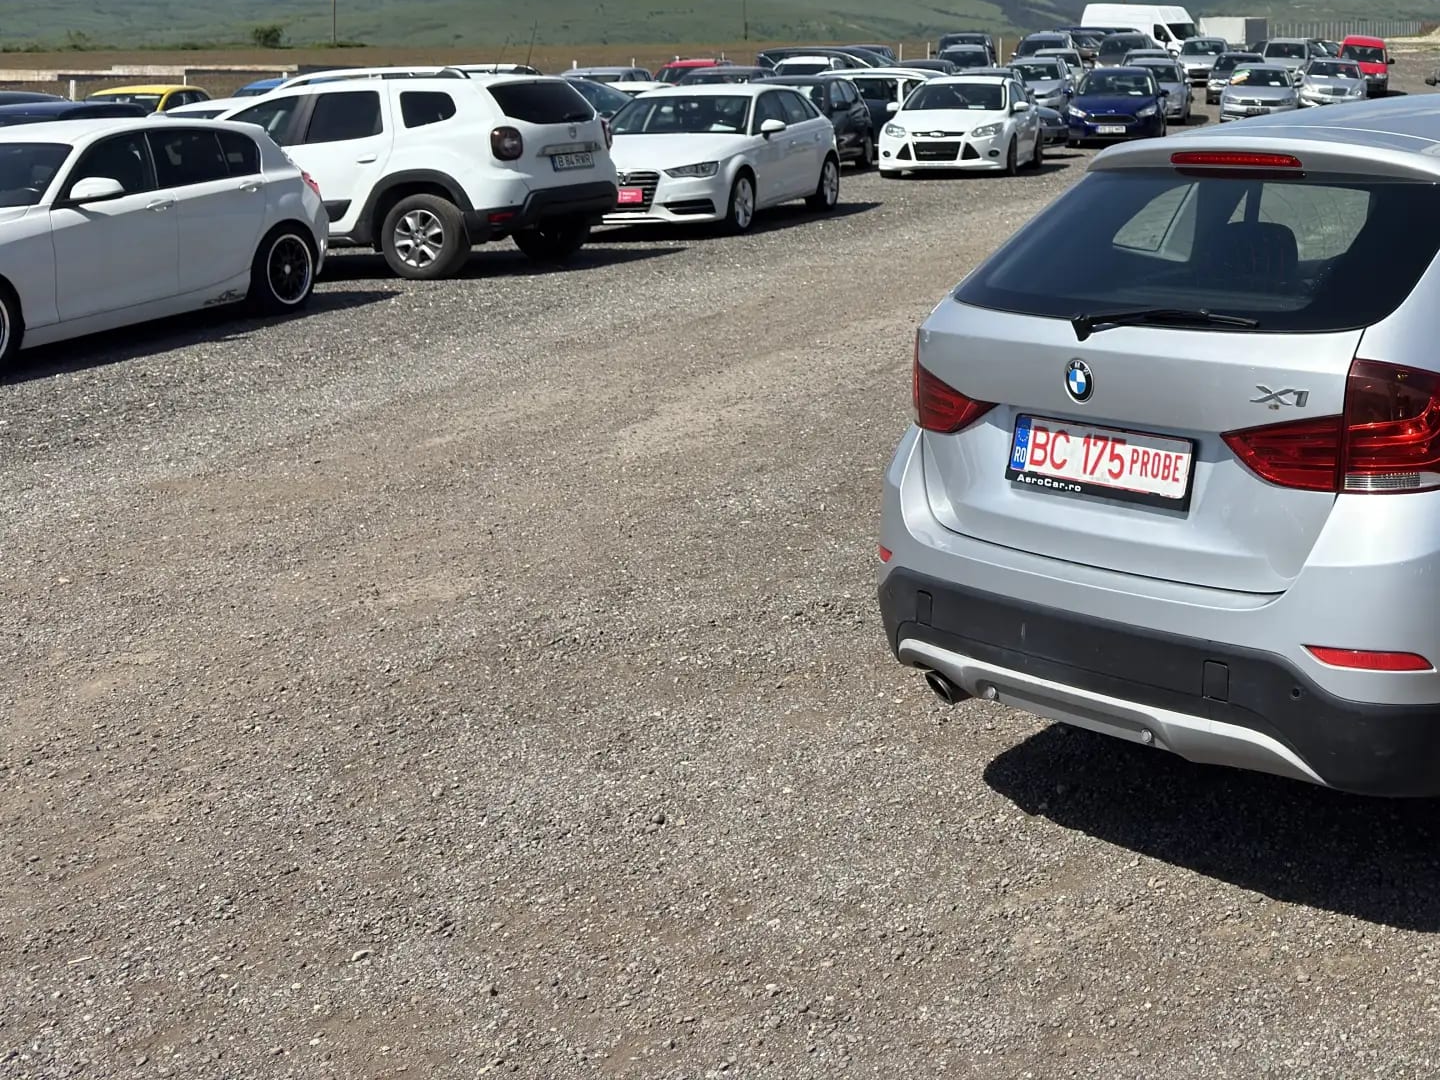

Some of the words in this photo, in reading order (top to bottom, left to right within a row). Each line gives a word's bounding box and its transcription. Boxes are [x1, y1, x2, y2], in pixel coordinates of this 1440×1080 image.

[1249, 385, 1309, 408] X1
[1014, 446, 1026, 463] RO
[1029, 426, 1070, 470] BC
[1082, 433, 1127, 480] 175
[1129, 448, 1183, 482] PROBE
[1016, 472, 1082, 493] AeroCar.ro
